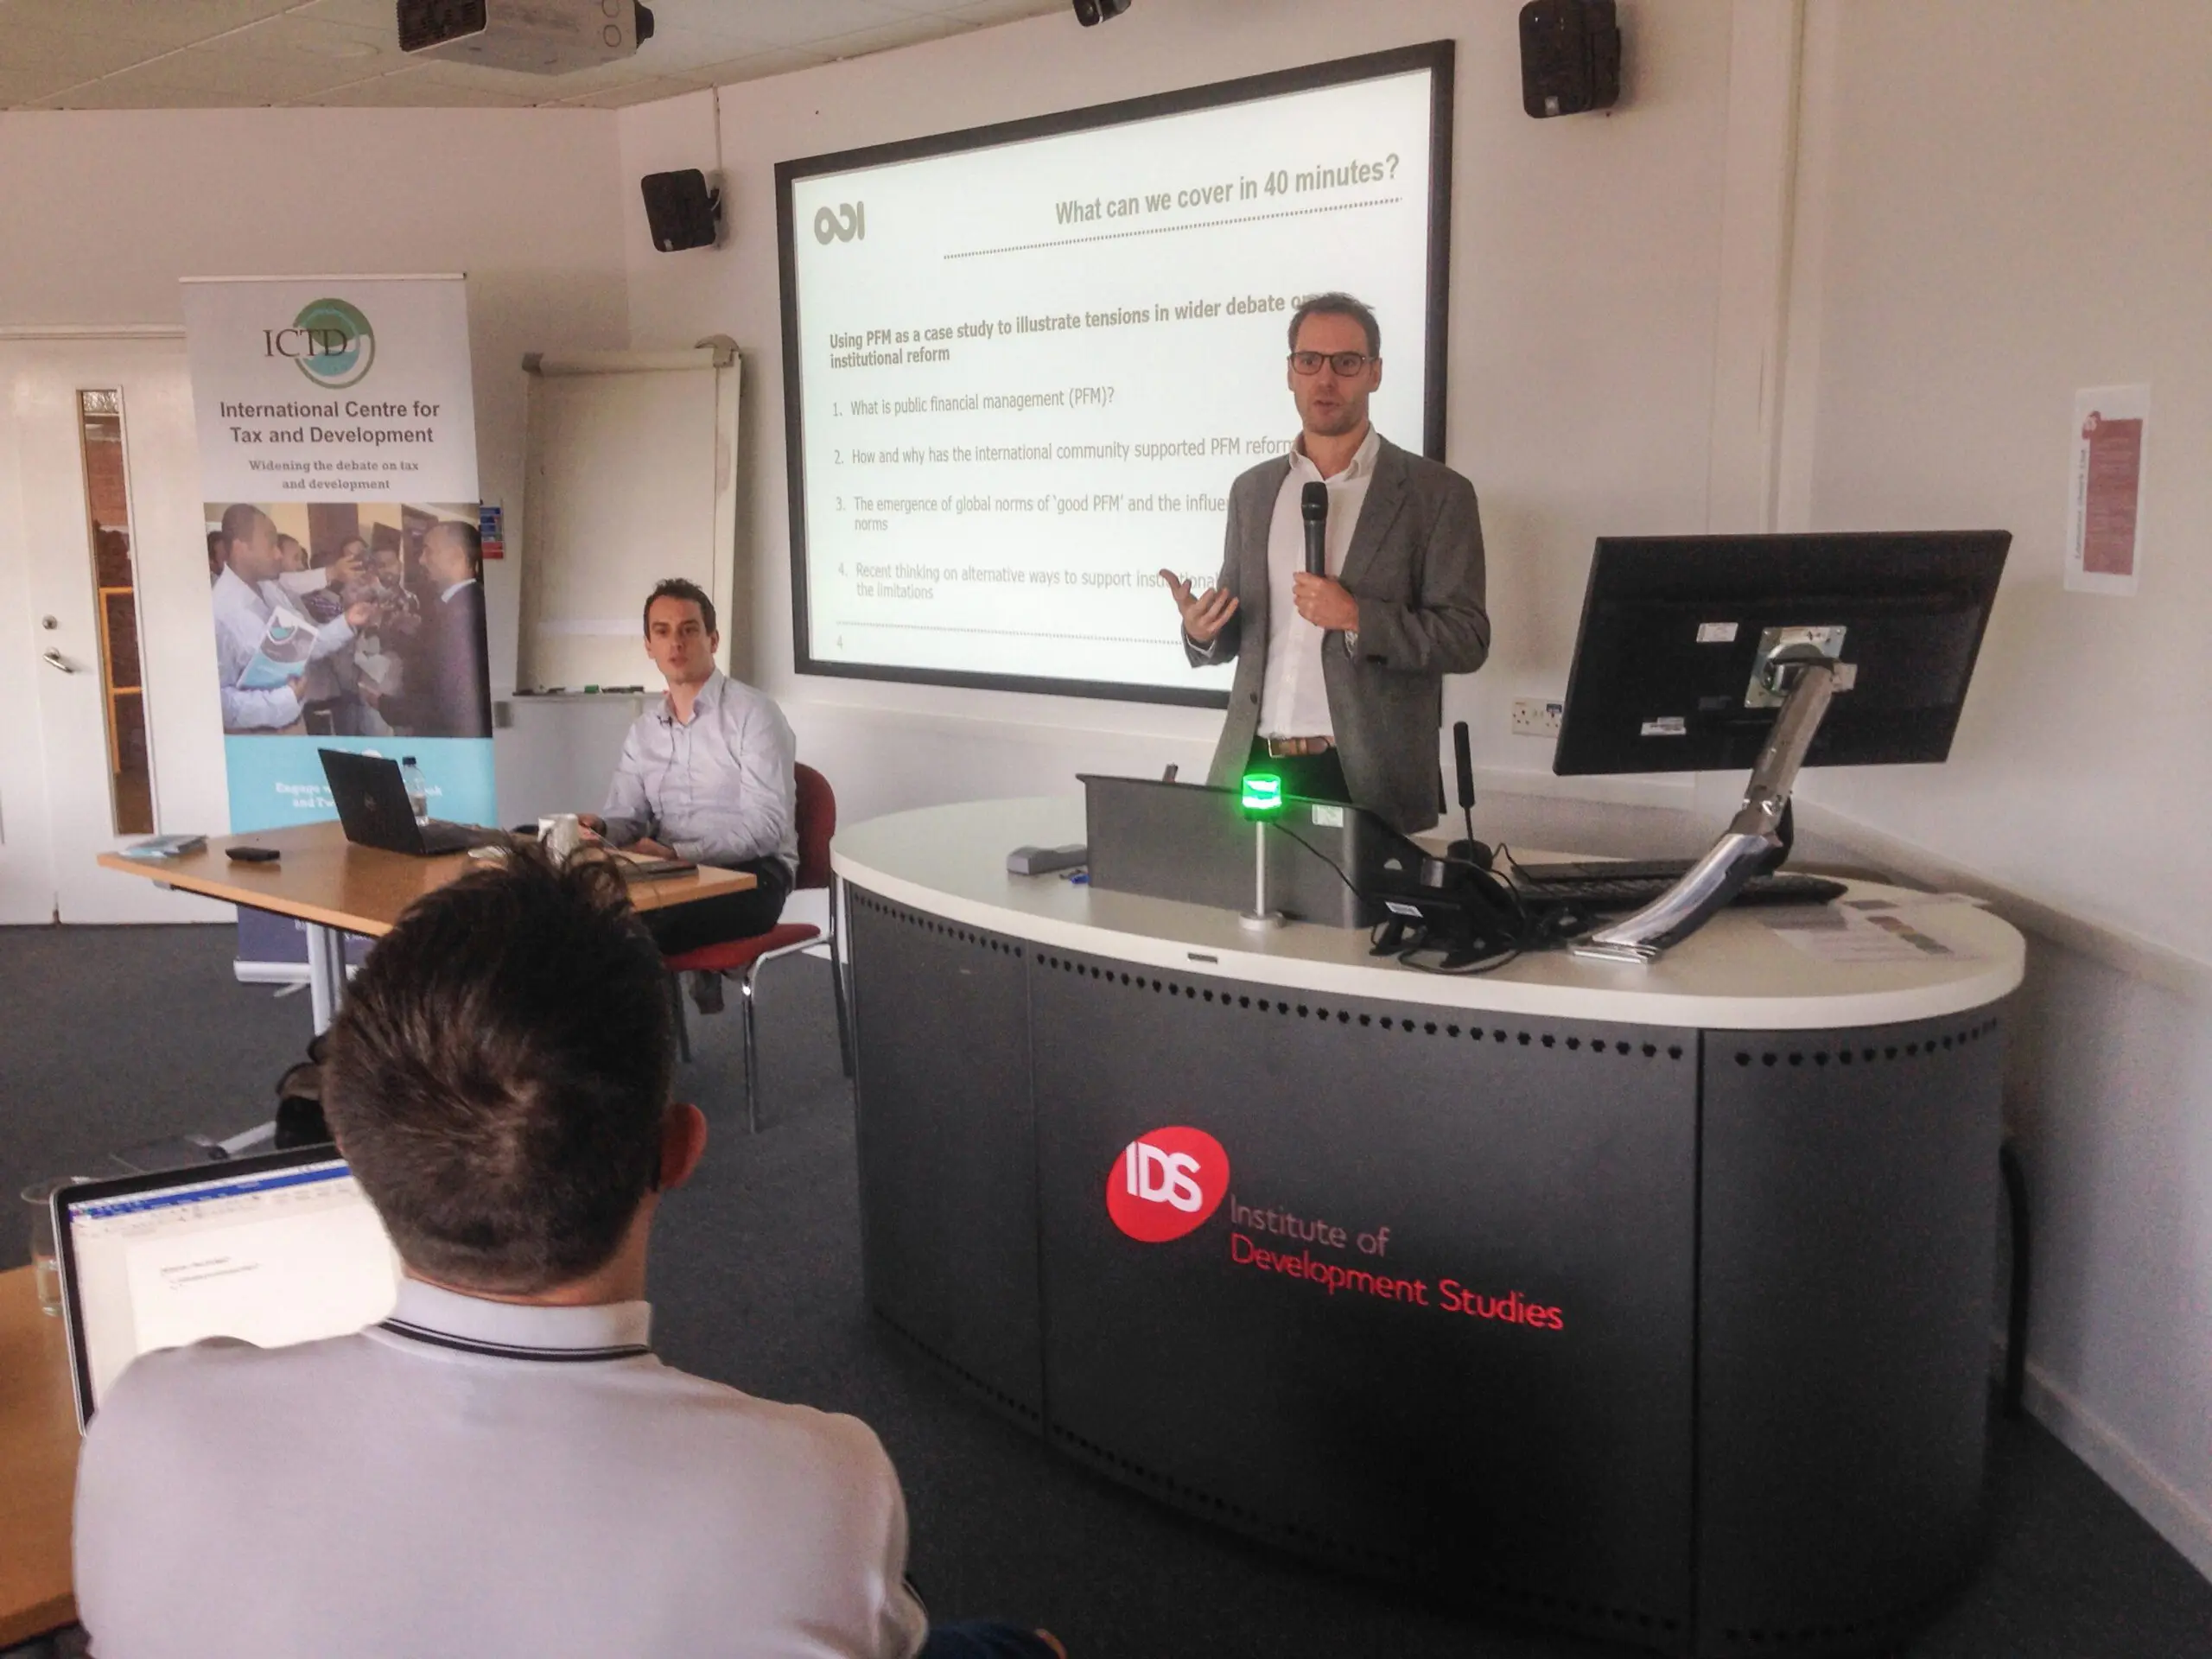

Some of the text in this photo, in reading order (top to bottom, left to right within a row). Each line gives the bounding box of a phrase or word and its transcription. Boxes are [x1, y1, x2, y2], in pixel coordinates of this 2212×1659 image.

[1056, 153, 1400, 225] What can we cover in 40 minutes?
[830, 334, 862, 350] Using
[867, 329, 891, 346] PFM
[895, 331, 909, 343] as
[912, 330, 920, 342] a
[924, 327, 953, 341] case
[957, 321, 994, 340] study
[998, 321, 1012, 335] to
[1016, 313, 1081, 334] illustrate
[1085, 304, 1149, 327] tensions
[1154, 301, 1169, 321] in
[1174, 296, 1221, 320] wider
[1226, 293, 1285, 317] debate
[263, 329, 348, 358] ICTD
[830, 346, 950, 368] institutional reform
[220, 400, 440, 417] International Centre for
[833, 386, 1115, 416] 1. What is public financial management (PFM)?
[230, 426, 434, 446] Tax and Development
[835, 449, 844, 464] 2.
[852, 448, 875, 463] How
[879, 448, 899, 463] and
[902, 447, 925, 465] why
[929, 447, 949, 462] has
[952, 446, 971, 461] the
[976, 443, 1052, 461] international
[1057, 442, 1129, 461] community
[1135, 439, 1205, 458] supported
[1211, 437, 1240, 455] PFM
[249, 461, 310, 473] Widening
[314, 461, 334, 471] the
[336, 461, 378, 471] debate
[400, 461, 419, 471] tax
[282, 479, 390, 492] and development
[836, 496, 845, 511] 3.
[854, 496, 874, 511] The
[877, 499, 937, 513] emergence
[941, 495, 952, 511] of
[956, 495, 990, 514] global
[995, 499, 1033, 512] norms
[1038, 495, 1050, 511] of
[1128, 495, 1153, 512] and
[1158, 494, 1180, 512] the
[1186, 493, 1228, 512] influe
[855, 518, 888, 531] norms
[856, 563, 892, 578] Recent
[895, 563, 939, 582] thinking
[944, 568, 957, 581] on
[962, 565, 1025, 583] alternative
[1029, 571, 1060, 587] ways
[1065, 569, 1077, 585] to
[1082, 570, 1131, 591] support
[857, 582, 933, 599] the limitations
[836, 635, 843, 650] 4
[1125, 1141, 1203, 1213] IDS
[1230, 1194, 1390, 1257] Institute of
[1230, 1232, 1564, 1330] Development Studies
